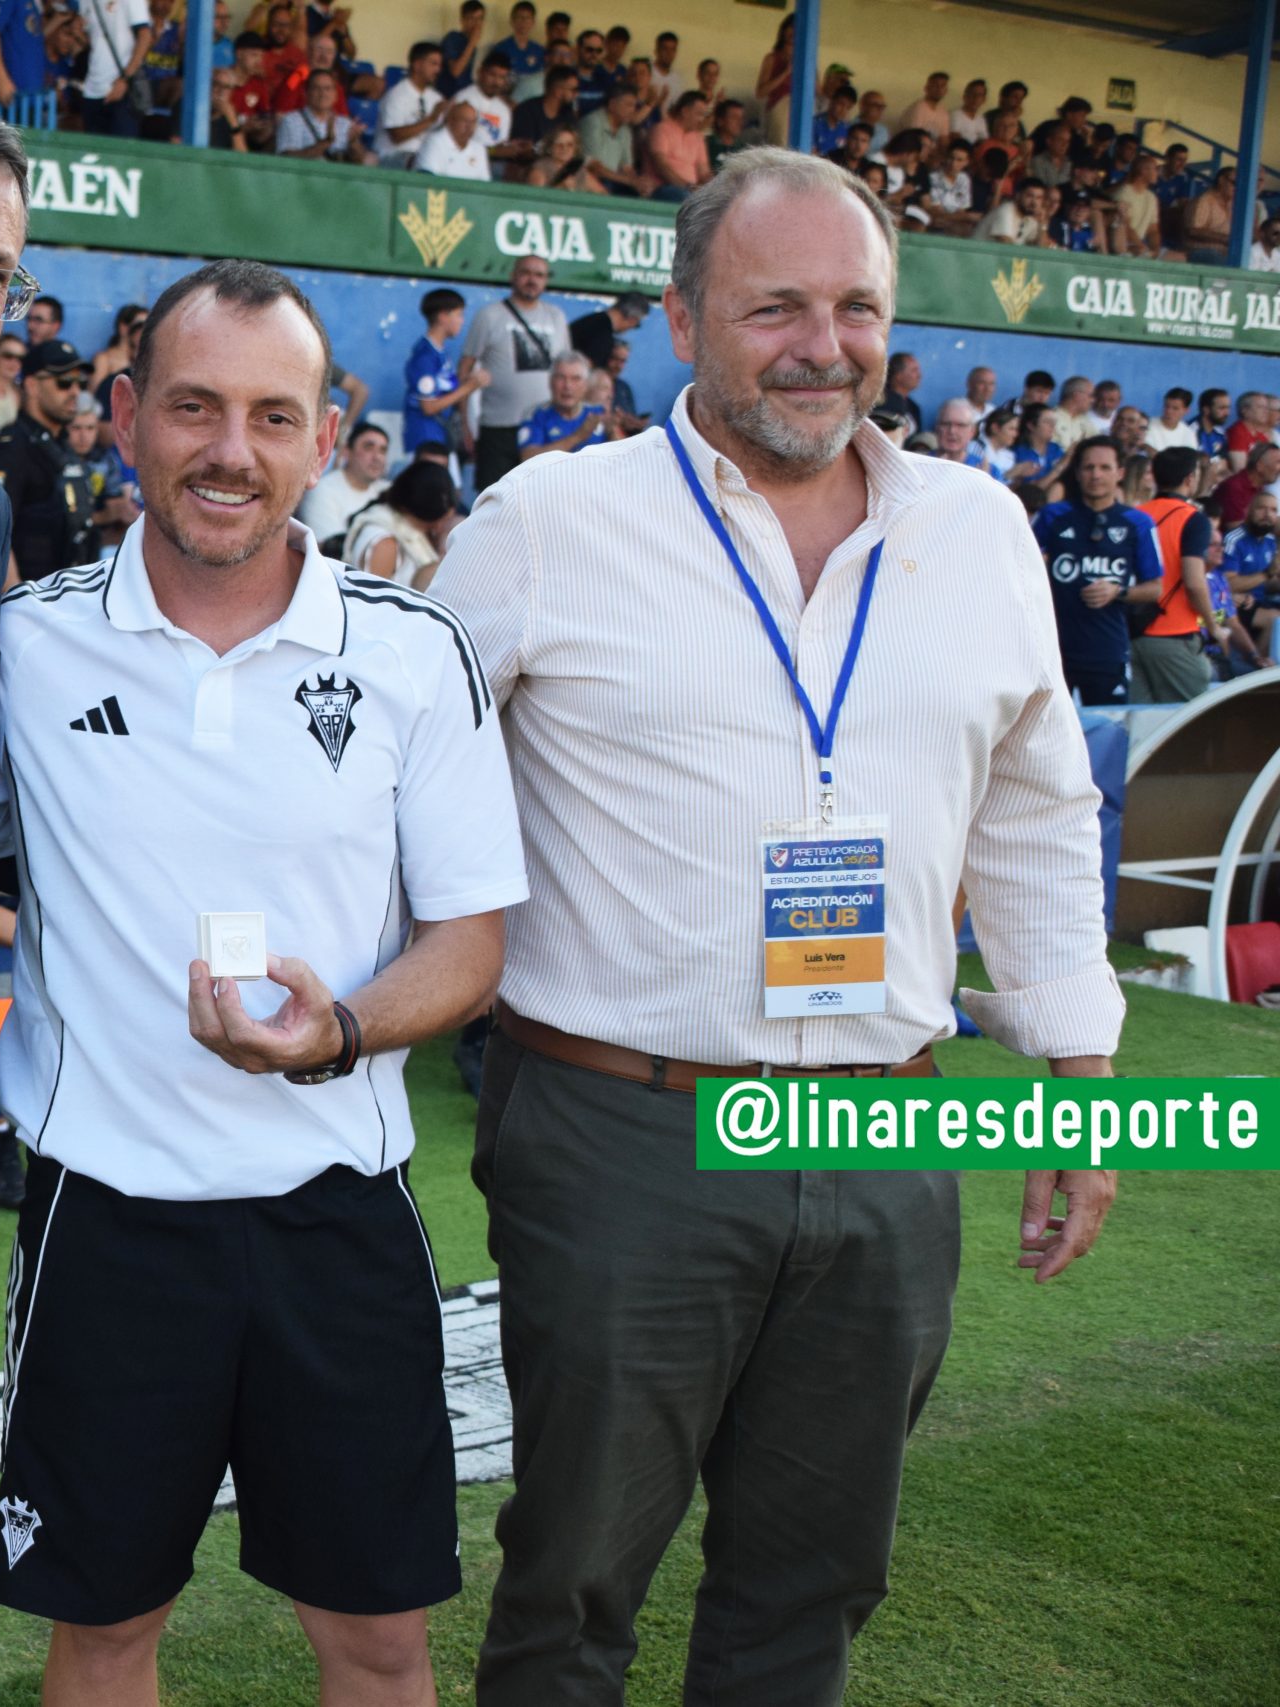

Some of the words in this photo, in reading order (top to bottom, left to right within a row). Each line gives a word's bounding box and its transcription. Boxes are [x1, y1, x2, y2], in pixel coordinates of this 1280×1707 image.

[495, 211, 594, 263] CAJA
[1066, 275, 1135, 318] CAJA
[1144, 282, 1239, 326] RURAL
[1081, 556, 1127, 576] MLC
[792, 845, 879, 857] PRETEMPORADA
[793, 857, 843, 867] AZULILLA
[770, 877, 810, 885] ESTADIO
[811, 875, 824, 884] DE
[824, 873, 878, 883] LINAREJOS
[771, 892, 873, 909] ACREDITACIÓN
[789, 907, 859, 930] CLUB
[804, 953, 823, 963] Luis
[824, 952, 846, 962] Vera
